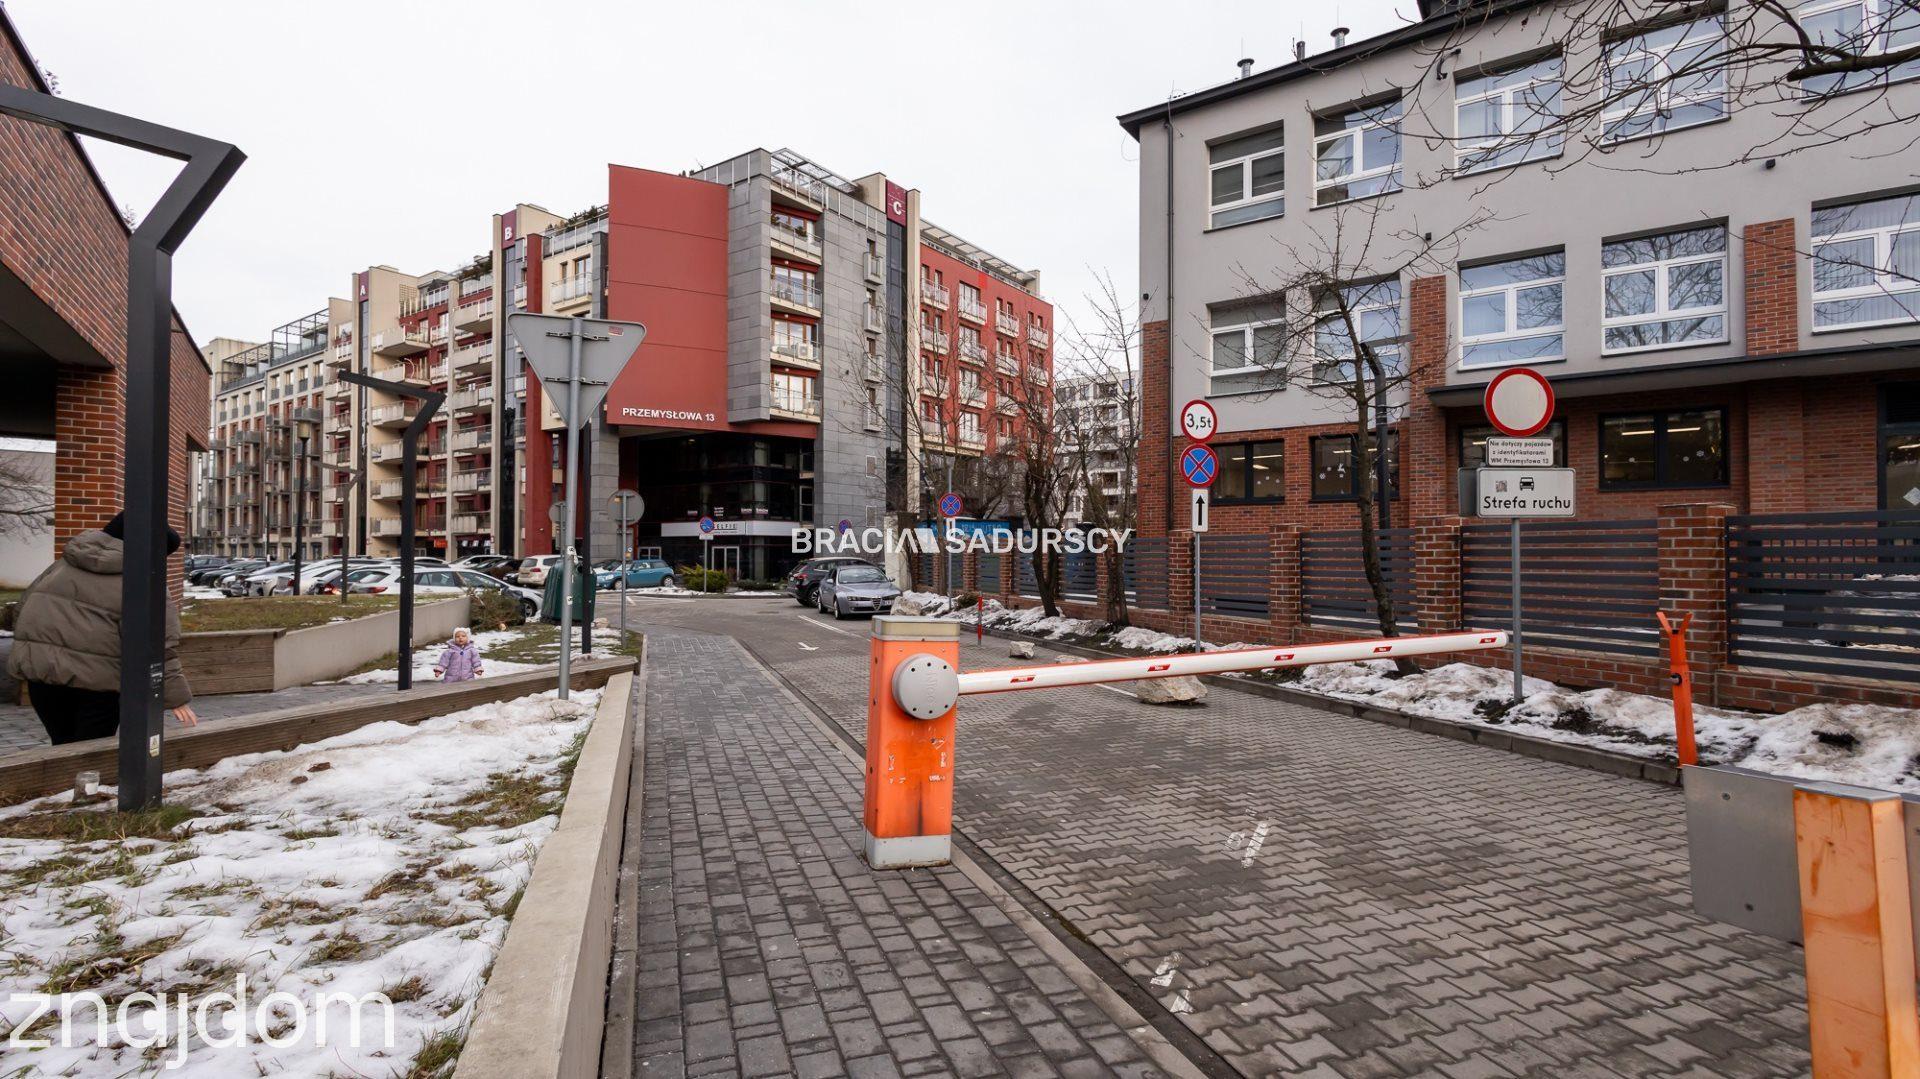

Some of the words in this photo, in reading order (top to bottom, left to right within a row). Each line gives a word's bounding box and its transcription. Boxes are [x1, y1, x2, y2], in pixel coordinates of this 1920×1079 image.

[893, 201, 902, 216] C
[504, 226, 513, 241] B
[360, 284, 367, 296] A
[622, 407, 703, 421] PRZEMYSŁOWA
[705, 413, 715, 422] 13
[1186, 413, 1212, 431] 3,5t
[1501, 440, 1523, 448] dotyczy
[1483, 496, 1526, 509] Strefa
[1532, 496, 1571, 509] ruchu
